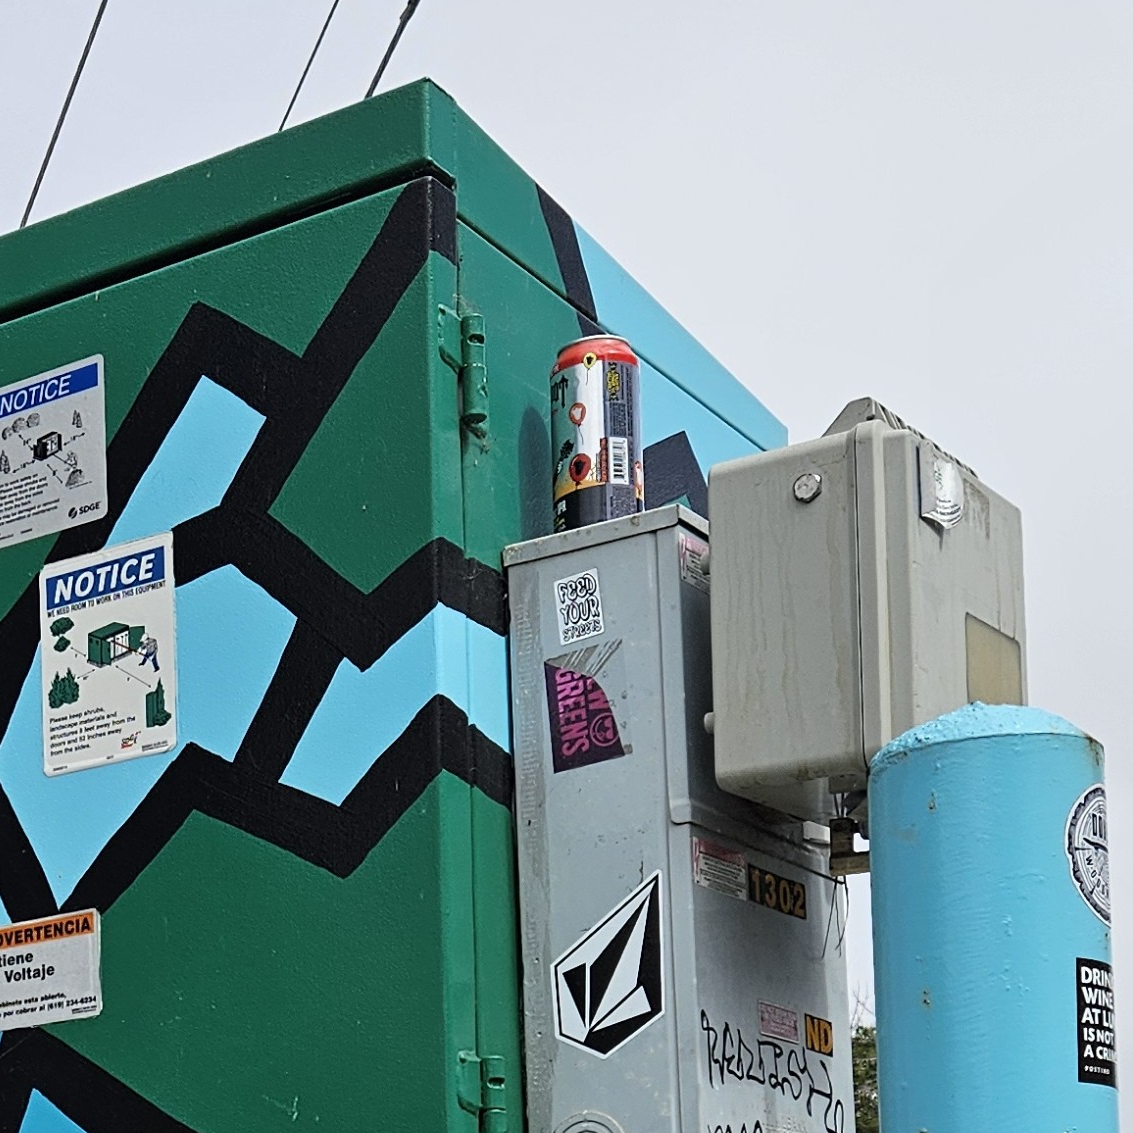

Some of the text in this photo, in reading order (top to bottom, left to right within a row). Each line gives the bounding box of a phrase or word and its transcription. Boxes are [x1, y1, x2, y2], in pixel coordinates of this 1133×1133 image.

[0, 374, 71, 416] NOTICE
[79, 501, 101, 515] SDGE
[54, 553, 156, 604] NOTICE
[558, 573, 597, 604] FEED
[559, 595, 600, 626] YOUR
[563, 618, 603, 642] STREETS
[554, 667, 590, 757] GREENS
[751, 868, 805, 917] 1302
[4, 964, 55, 985] Voltaje
[1081, 966, 1114, 988] DRIN
[1081, 986, 1114, 1010] WINE
[1081, 1007, 1102, 1025] AT
[806, 1015, 833, 1054] ND
[1083, 1027, 1115, 1046] IS NOT
[1083, 1044, 1117, 1062] A CRIM
